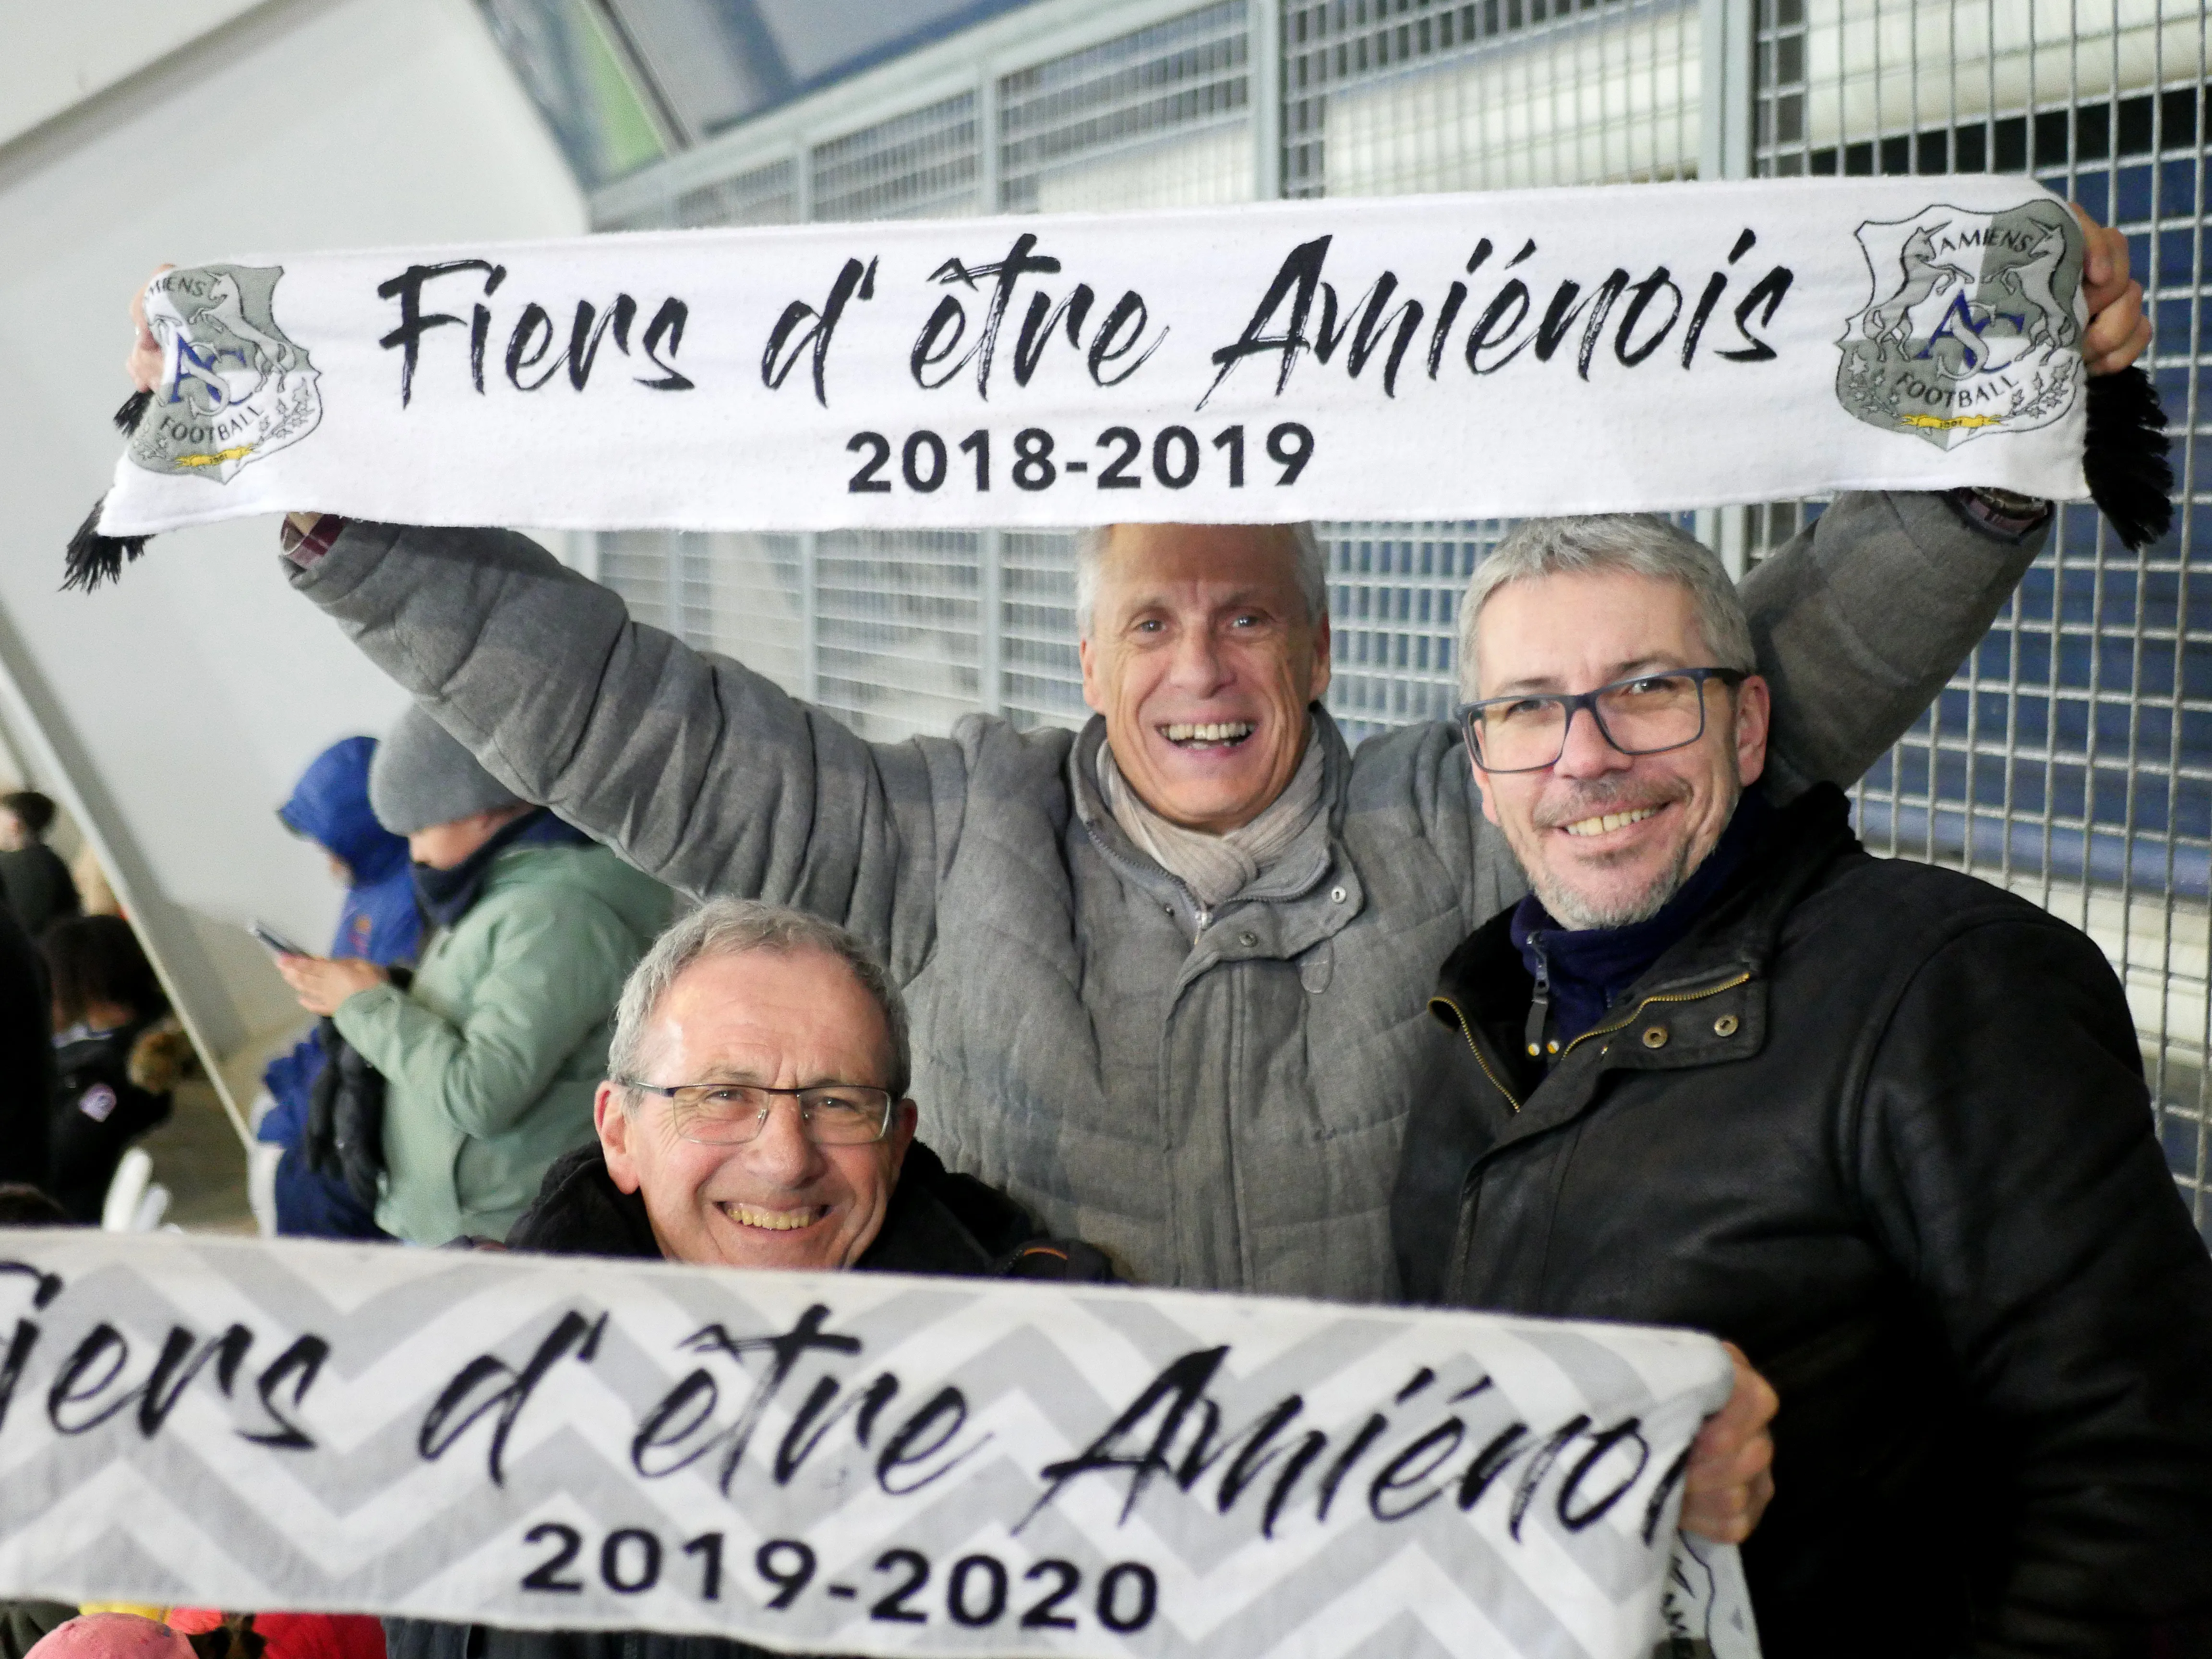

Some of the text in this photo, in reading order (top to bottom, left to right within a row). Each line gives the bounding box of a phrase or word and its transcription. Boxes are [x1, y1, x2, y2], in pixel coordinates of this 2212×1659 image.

[1940, 228, 2033, 256] AMIENS
[377, 228, 1794, 414] Fiers d' être Amiénois
[160, 405, 265, 444] FOOTBALL
[1896, 373, 2019, 409] FOOTBALL
[847, 422, 1314, 493] 2018-2019
[0, 1260, 1693, 1548] iers d' être Amiénoi
[521, 1522, 1158, 1634] 2019-2020
